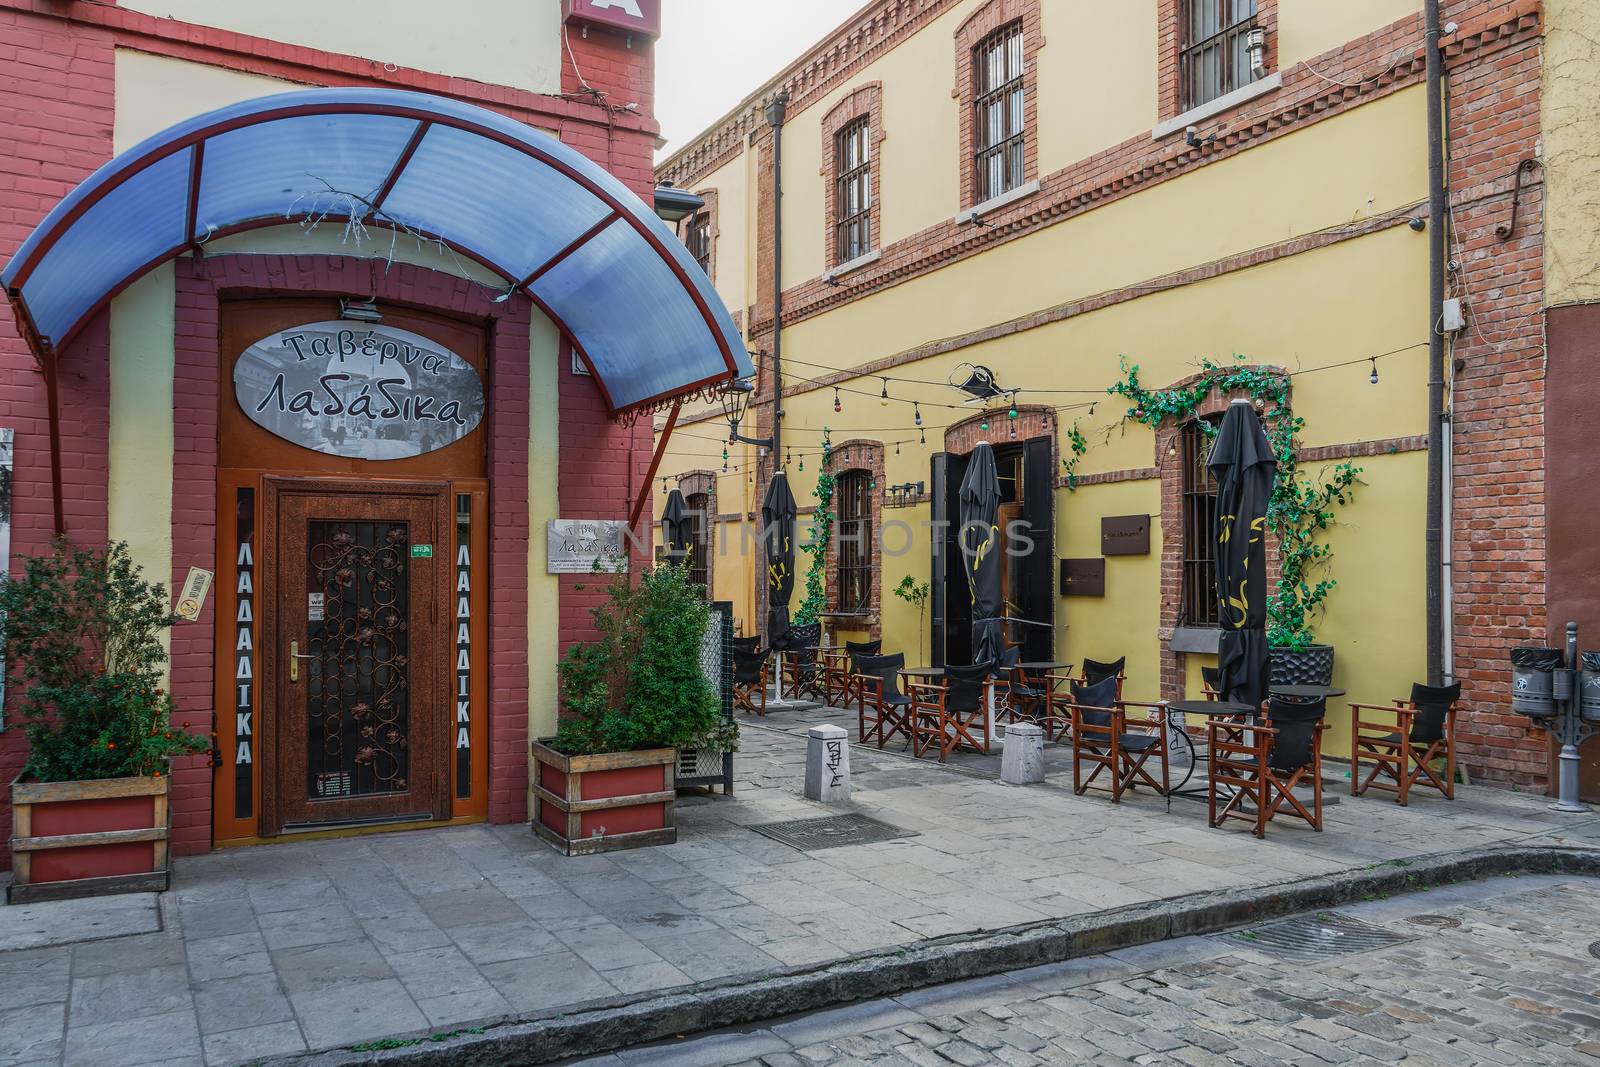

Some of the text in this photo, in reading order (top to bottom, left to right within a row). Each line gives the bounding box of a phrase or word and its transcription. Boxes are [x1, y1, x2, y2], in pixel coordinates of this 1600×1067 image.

[255, 373, 466, 427] Λαδάδικα
[281, 329, 446, 376] Ταβέρνα
[236, 542, 254, 764] ΛΑΔΑΔΙΚΑ
[456, 544, 471, 749] ΛΑΔΑΔΙΚΑ
